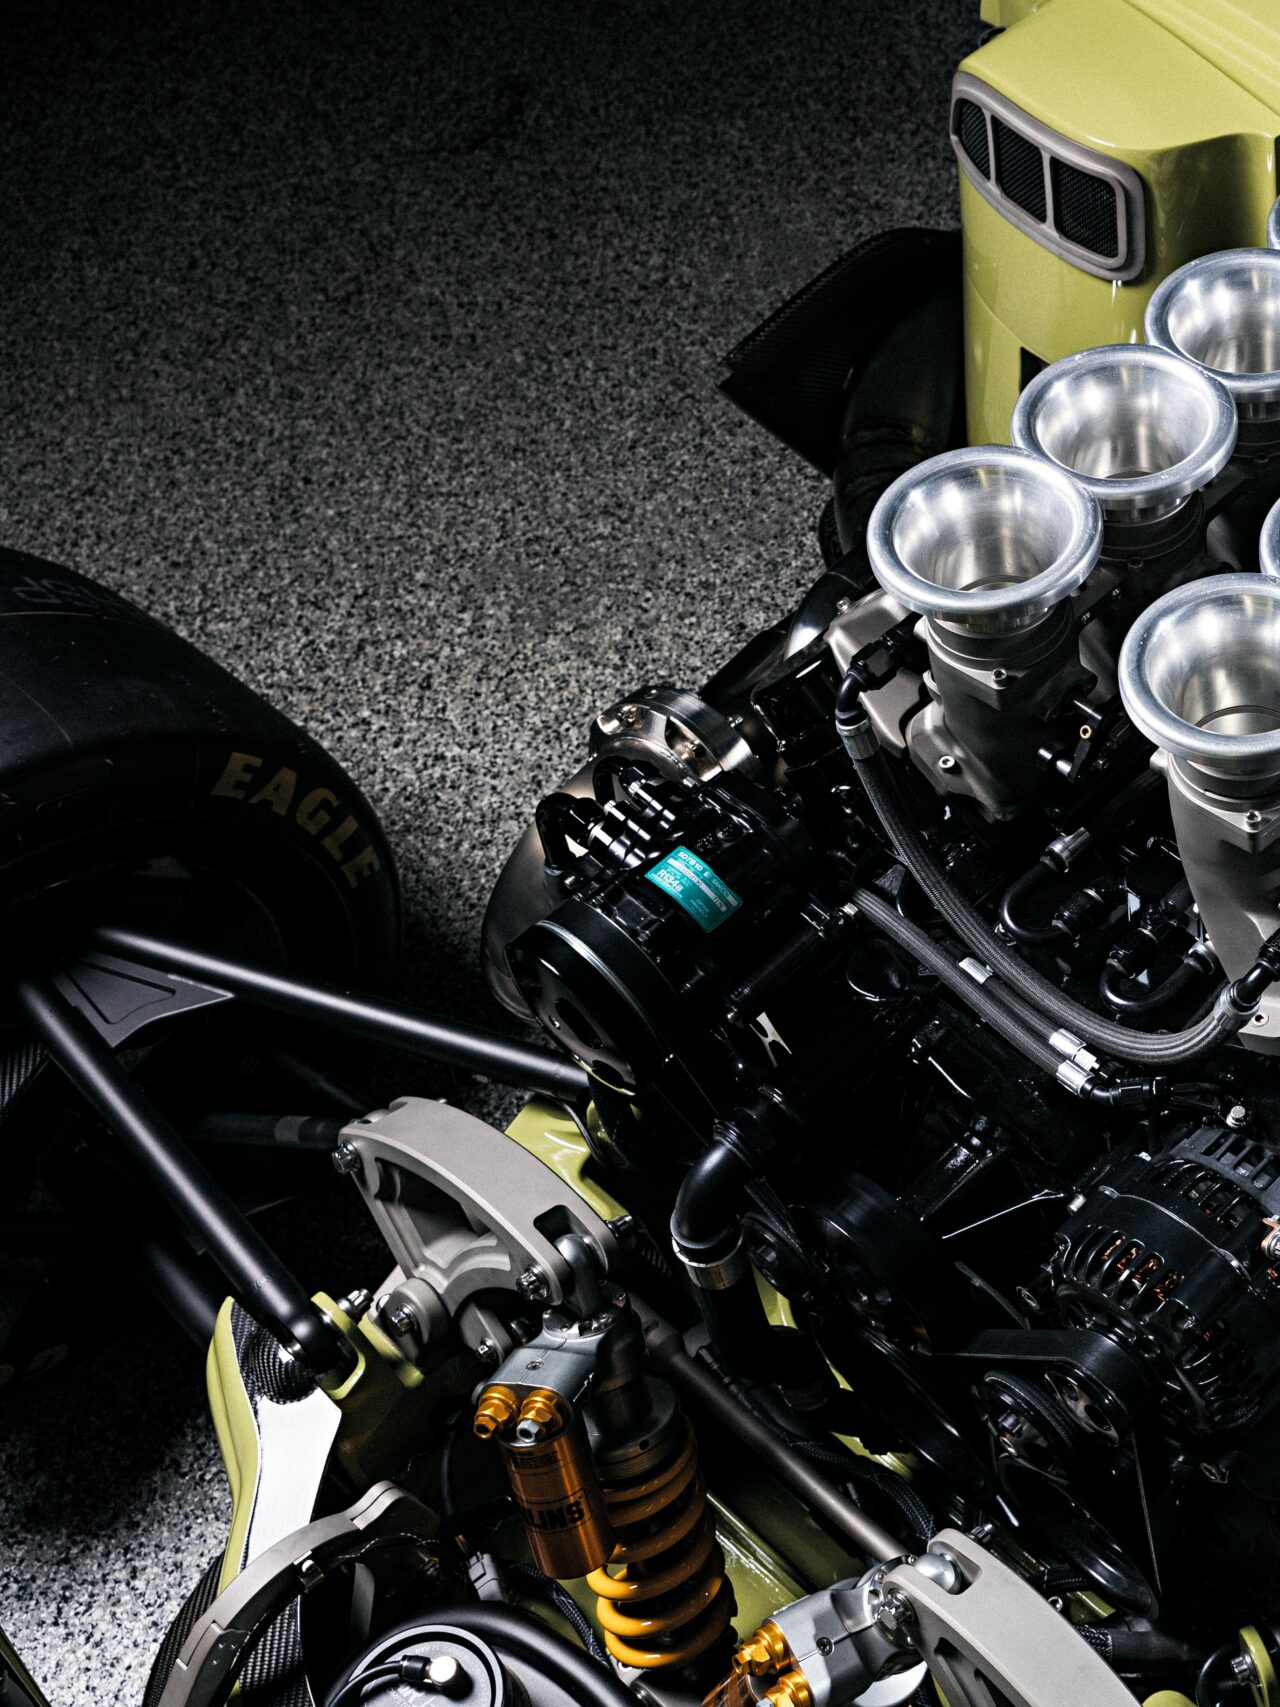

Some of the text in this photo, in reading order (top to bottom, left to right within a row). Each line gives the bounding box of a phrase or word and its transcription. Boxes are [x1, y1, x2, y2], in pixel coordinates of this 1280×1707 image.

[209, 752, 382, 888] EAGLE
[656, 869, 684, 892] R134a
[526, 1500, 585, 1531] LINS
